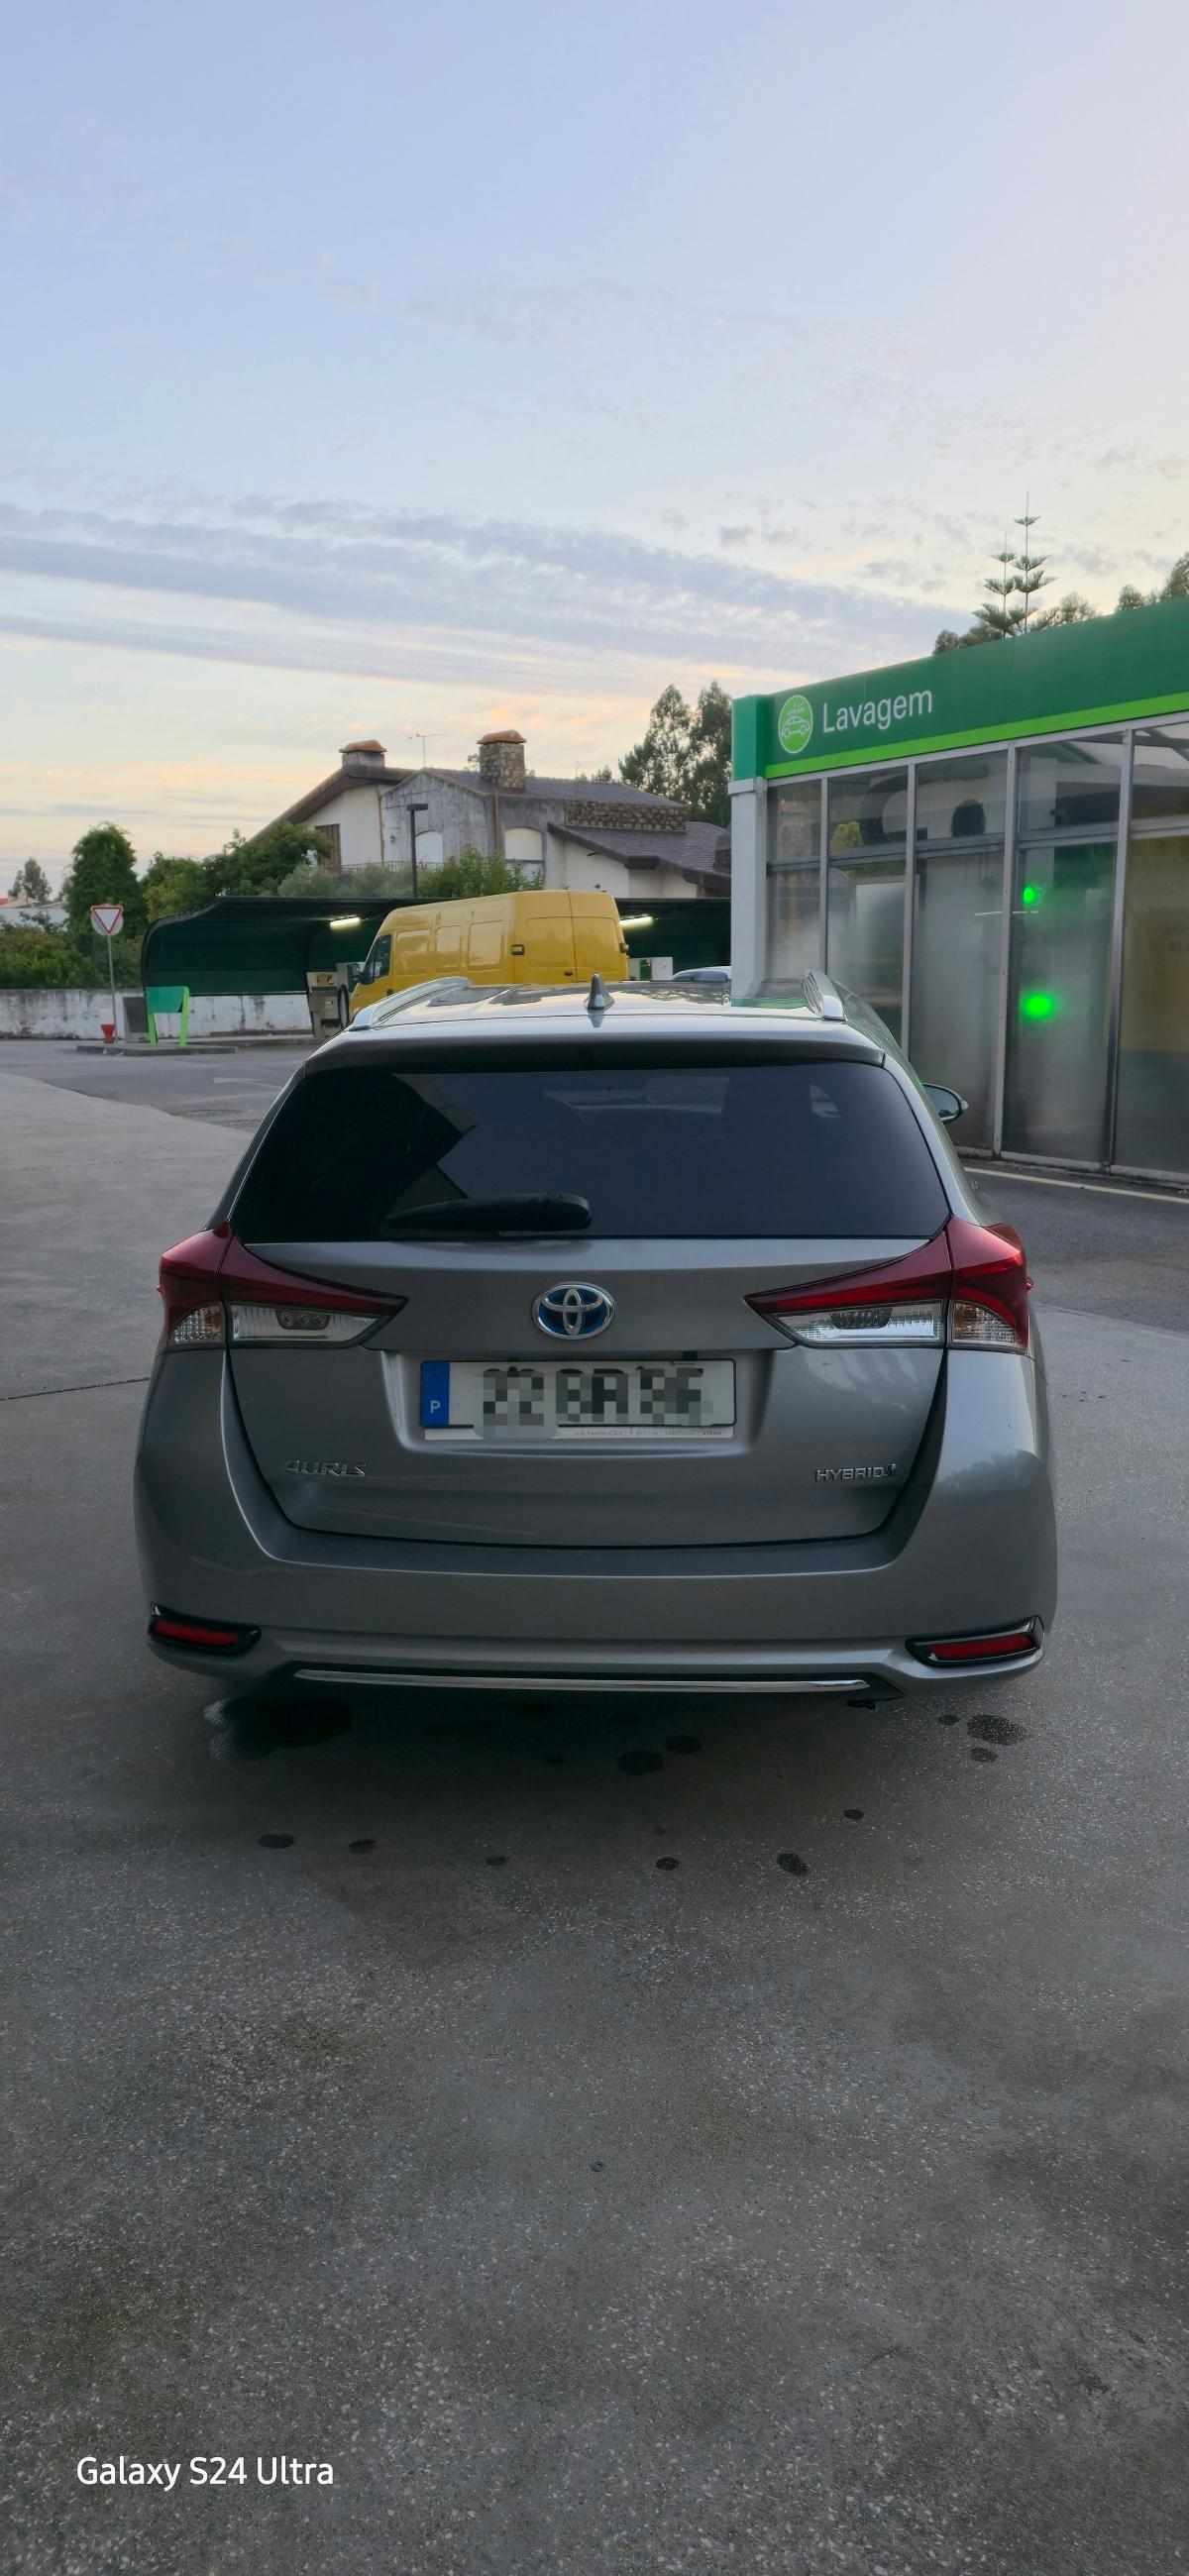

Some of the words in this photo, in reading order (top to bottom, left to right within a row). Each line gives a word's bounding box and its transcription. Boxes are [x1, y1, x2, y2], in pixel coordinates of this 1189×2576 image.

[823, 690, 932, 733] Lavagem
[429, 1400, 441, 1415] P
[815, 1466, 888, 1482] HYBRID
